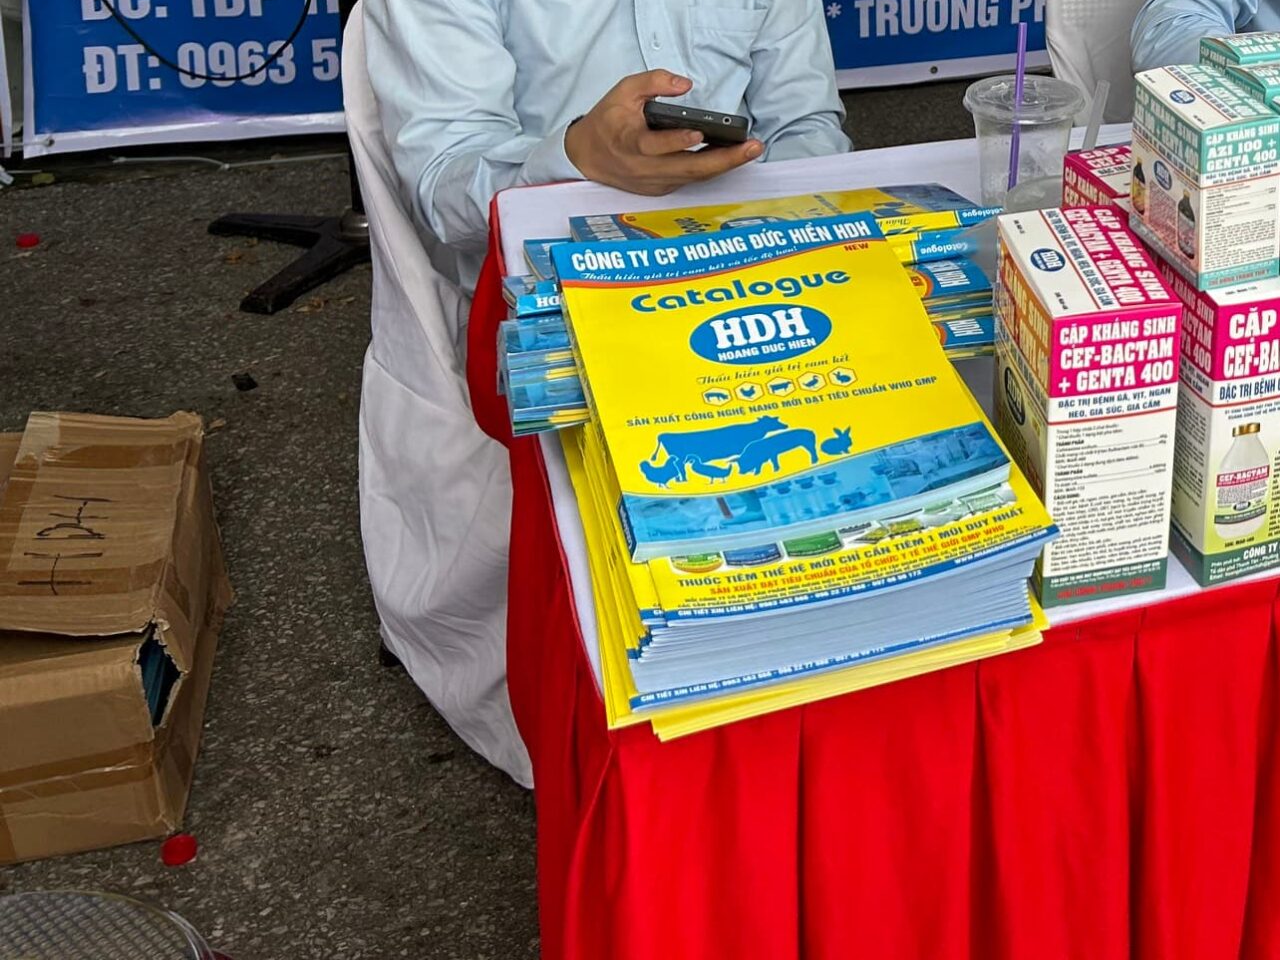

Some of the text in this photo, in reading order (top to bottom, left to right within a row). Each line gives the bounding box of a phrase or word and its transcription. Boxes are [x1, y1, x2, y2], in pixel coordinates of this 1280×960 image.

[83, 44, 162, 94] ĐT:
[177, 40, 297, 89] 0963
[571, 220, 871, 271] CÔNG TY CP HOÀNG ĐỨC HIỀN HDH
[844, 242, 869, 251] NEW
[630, 269, 852, 313] Catalogue
[709, 307, 810, 350] HDH
[1092, 317, 1139, 342] KHÁNG
[1143, 315, 1176, 336] SINH
[718, 337, 817, 361] HOANG DUC HIEN
[1061, 337, 1174, 370] CEF-BACTAM
[1076, 360, 1174, 391] GENTA 400
